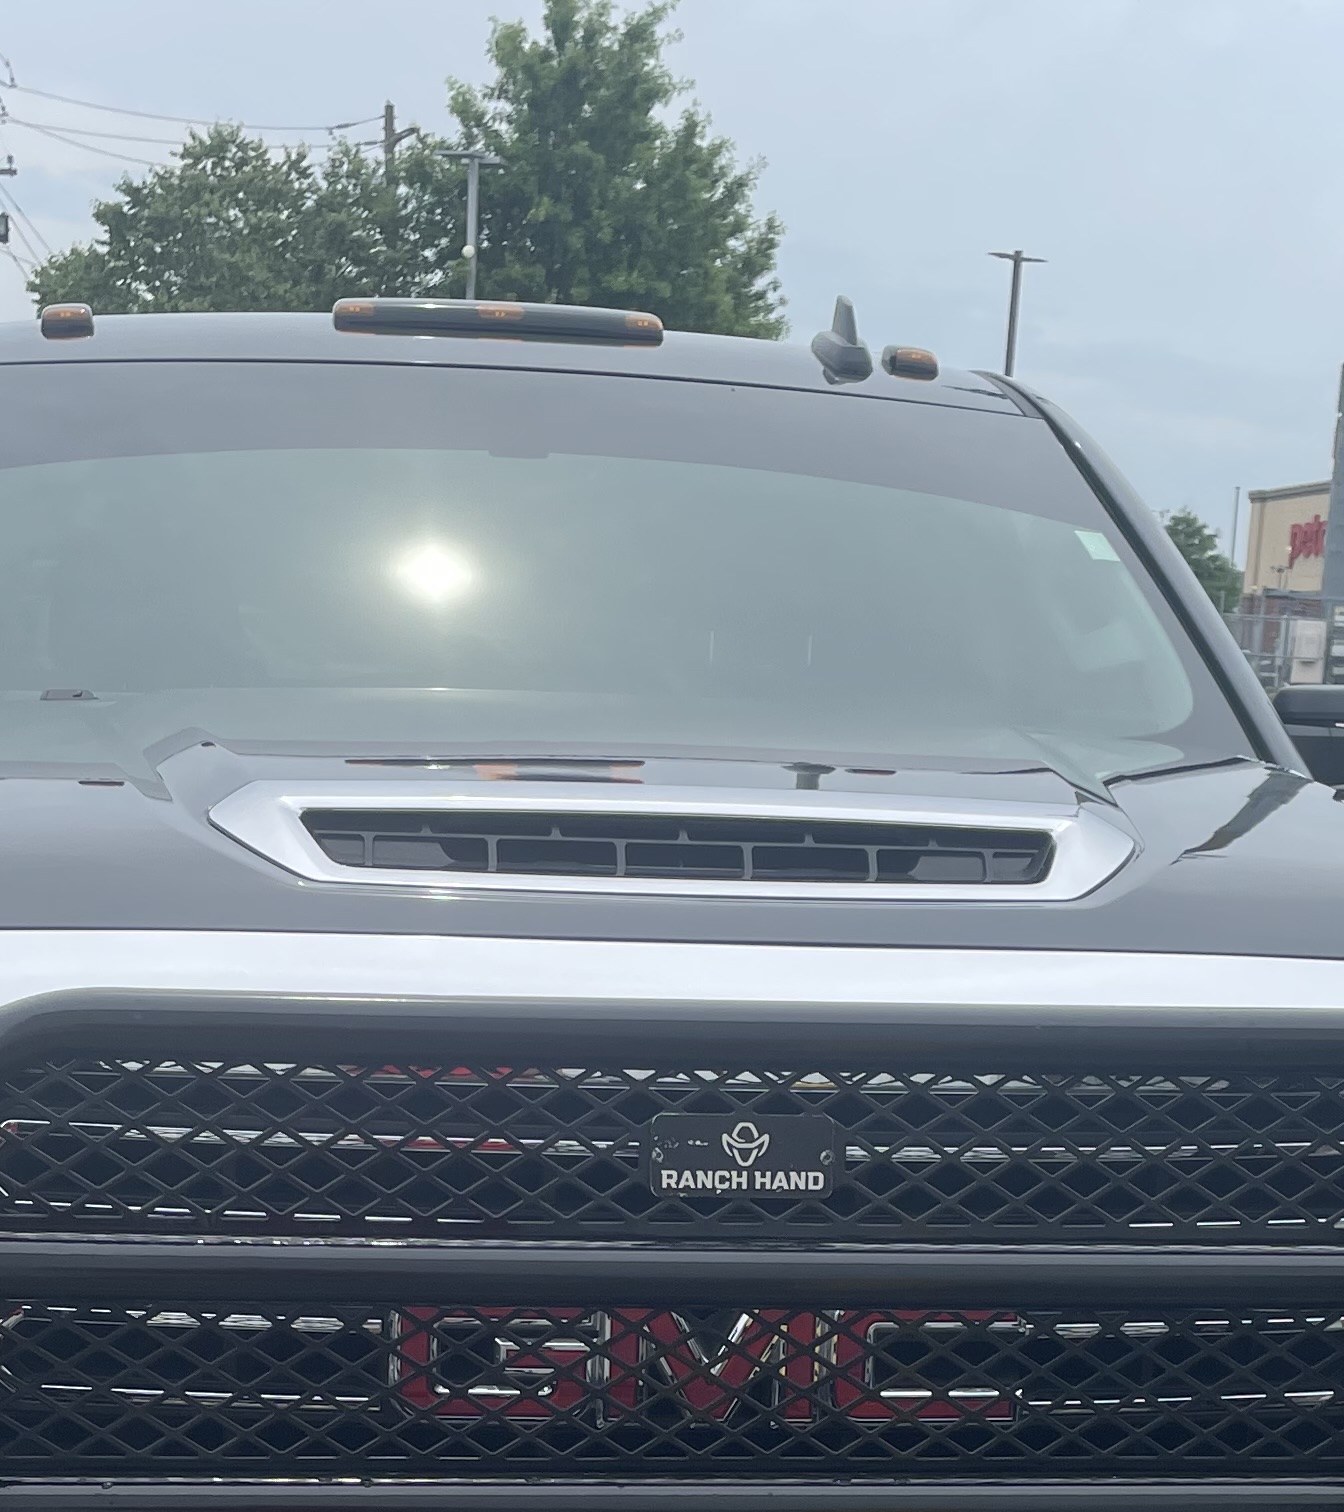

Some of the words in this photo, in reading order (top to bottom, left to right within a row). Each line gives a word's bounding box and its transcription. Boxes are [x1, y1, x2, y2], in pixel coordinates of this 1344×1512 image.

[660, 1169, 749, 1190] RANCH
[754, 1170, 825, 1191] HAND
[387, 1304, 1028, 1430] GMC
